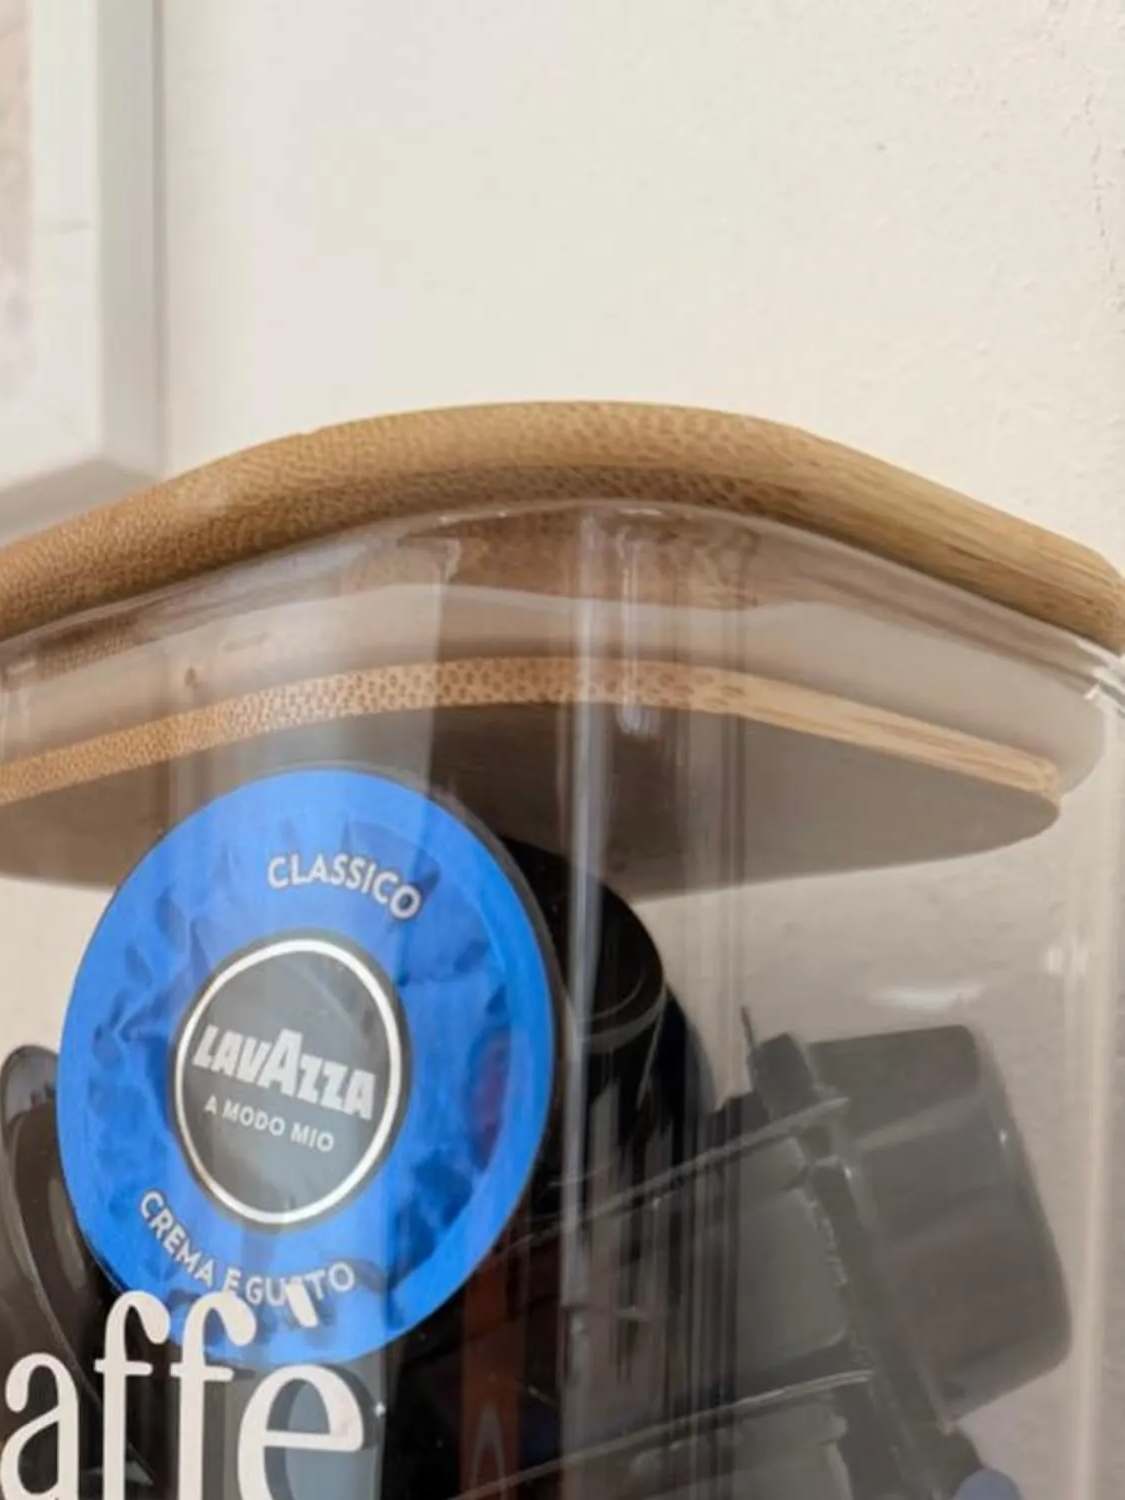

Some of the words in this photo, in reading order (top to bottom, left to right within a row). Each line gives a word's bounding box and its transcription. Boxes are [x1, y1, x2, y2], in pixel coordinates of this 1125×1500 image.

[266, 853, 422, 922] CLASSICO
[192, 1023, 377, 1121] LAVAZZA
[204, 1093, 218, 1116] A
[222, 1098, 286, 1137] MODO
[290, 1121, 336, 1153] MIO
[140, 1189, 217, 1288] CREMA
[245, 1261, 356, 1307] GUTO
